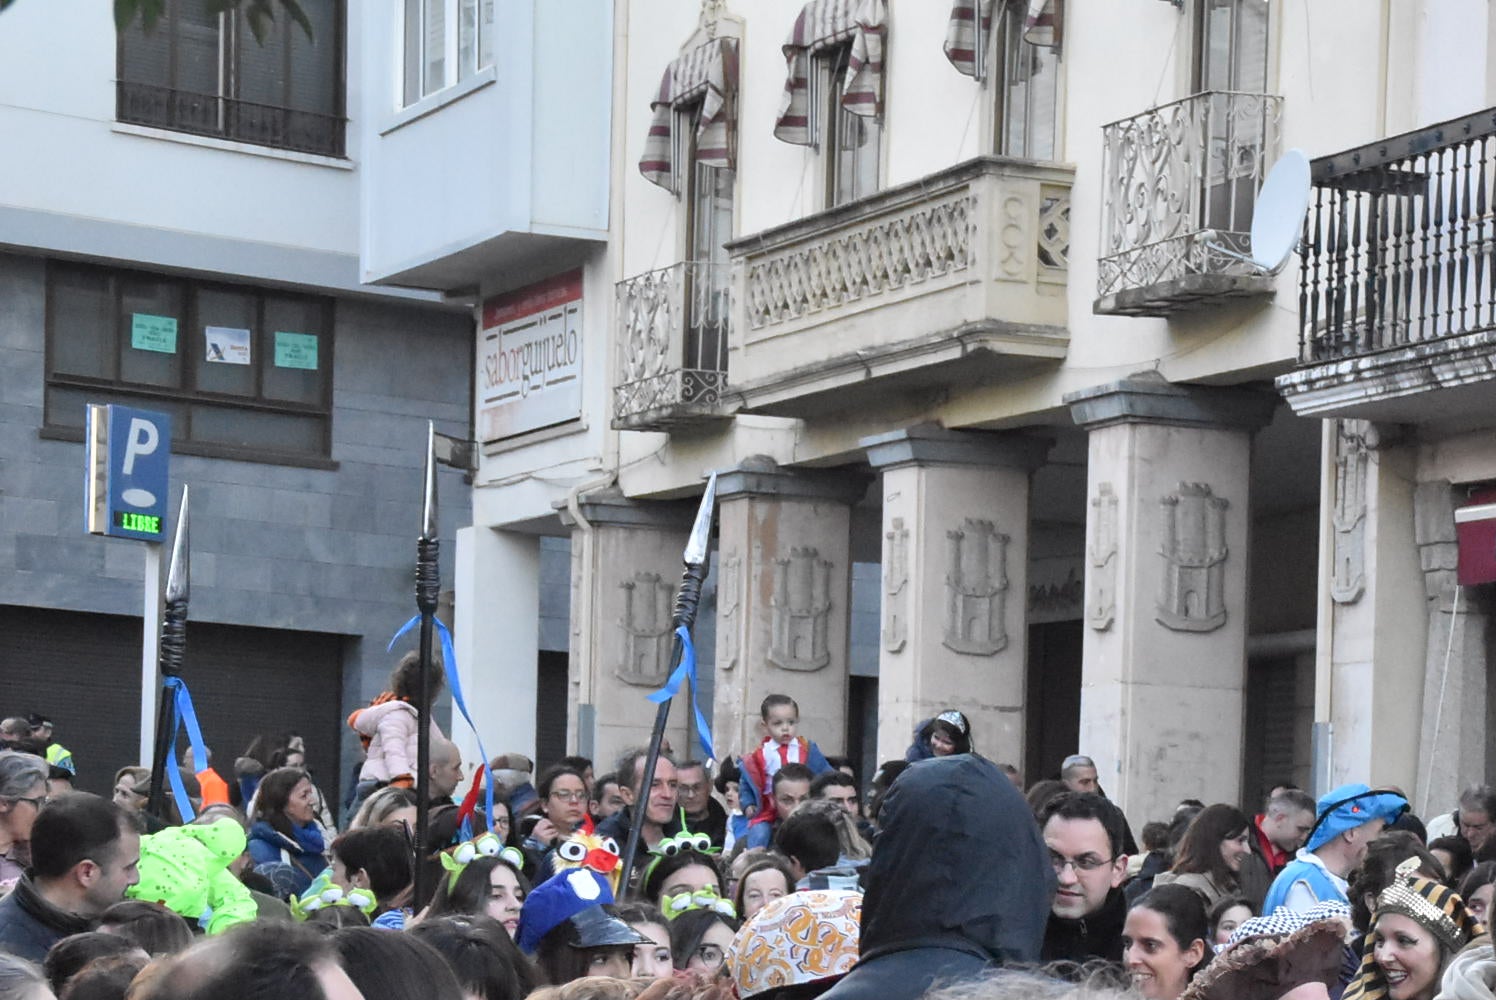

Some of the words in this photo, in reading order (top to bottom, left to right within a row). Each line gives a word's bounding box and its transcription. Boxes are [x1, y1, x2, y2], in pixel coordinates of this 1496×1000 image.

[485, 304, 578, 399] saborguijuelo
[122, 417, 160, 476] P
[122, 512, 160, 534] LIBRE
